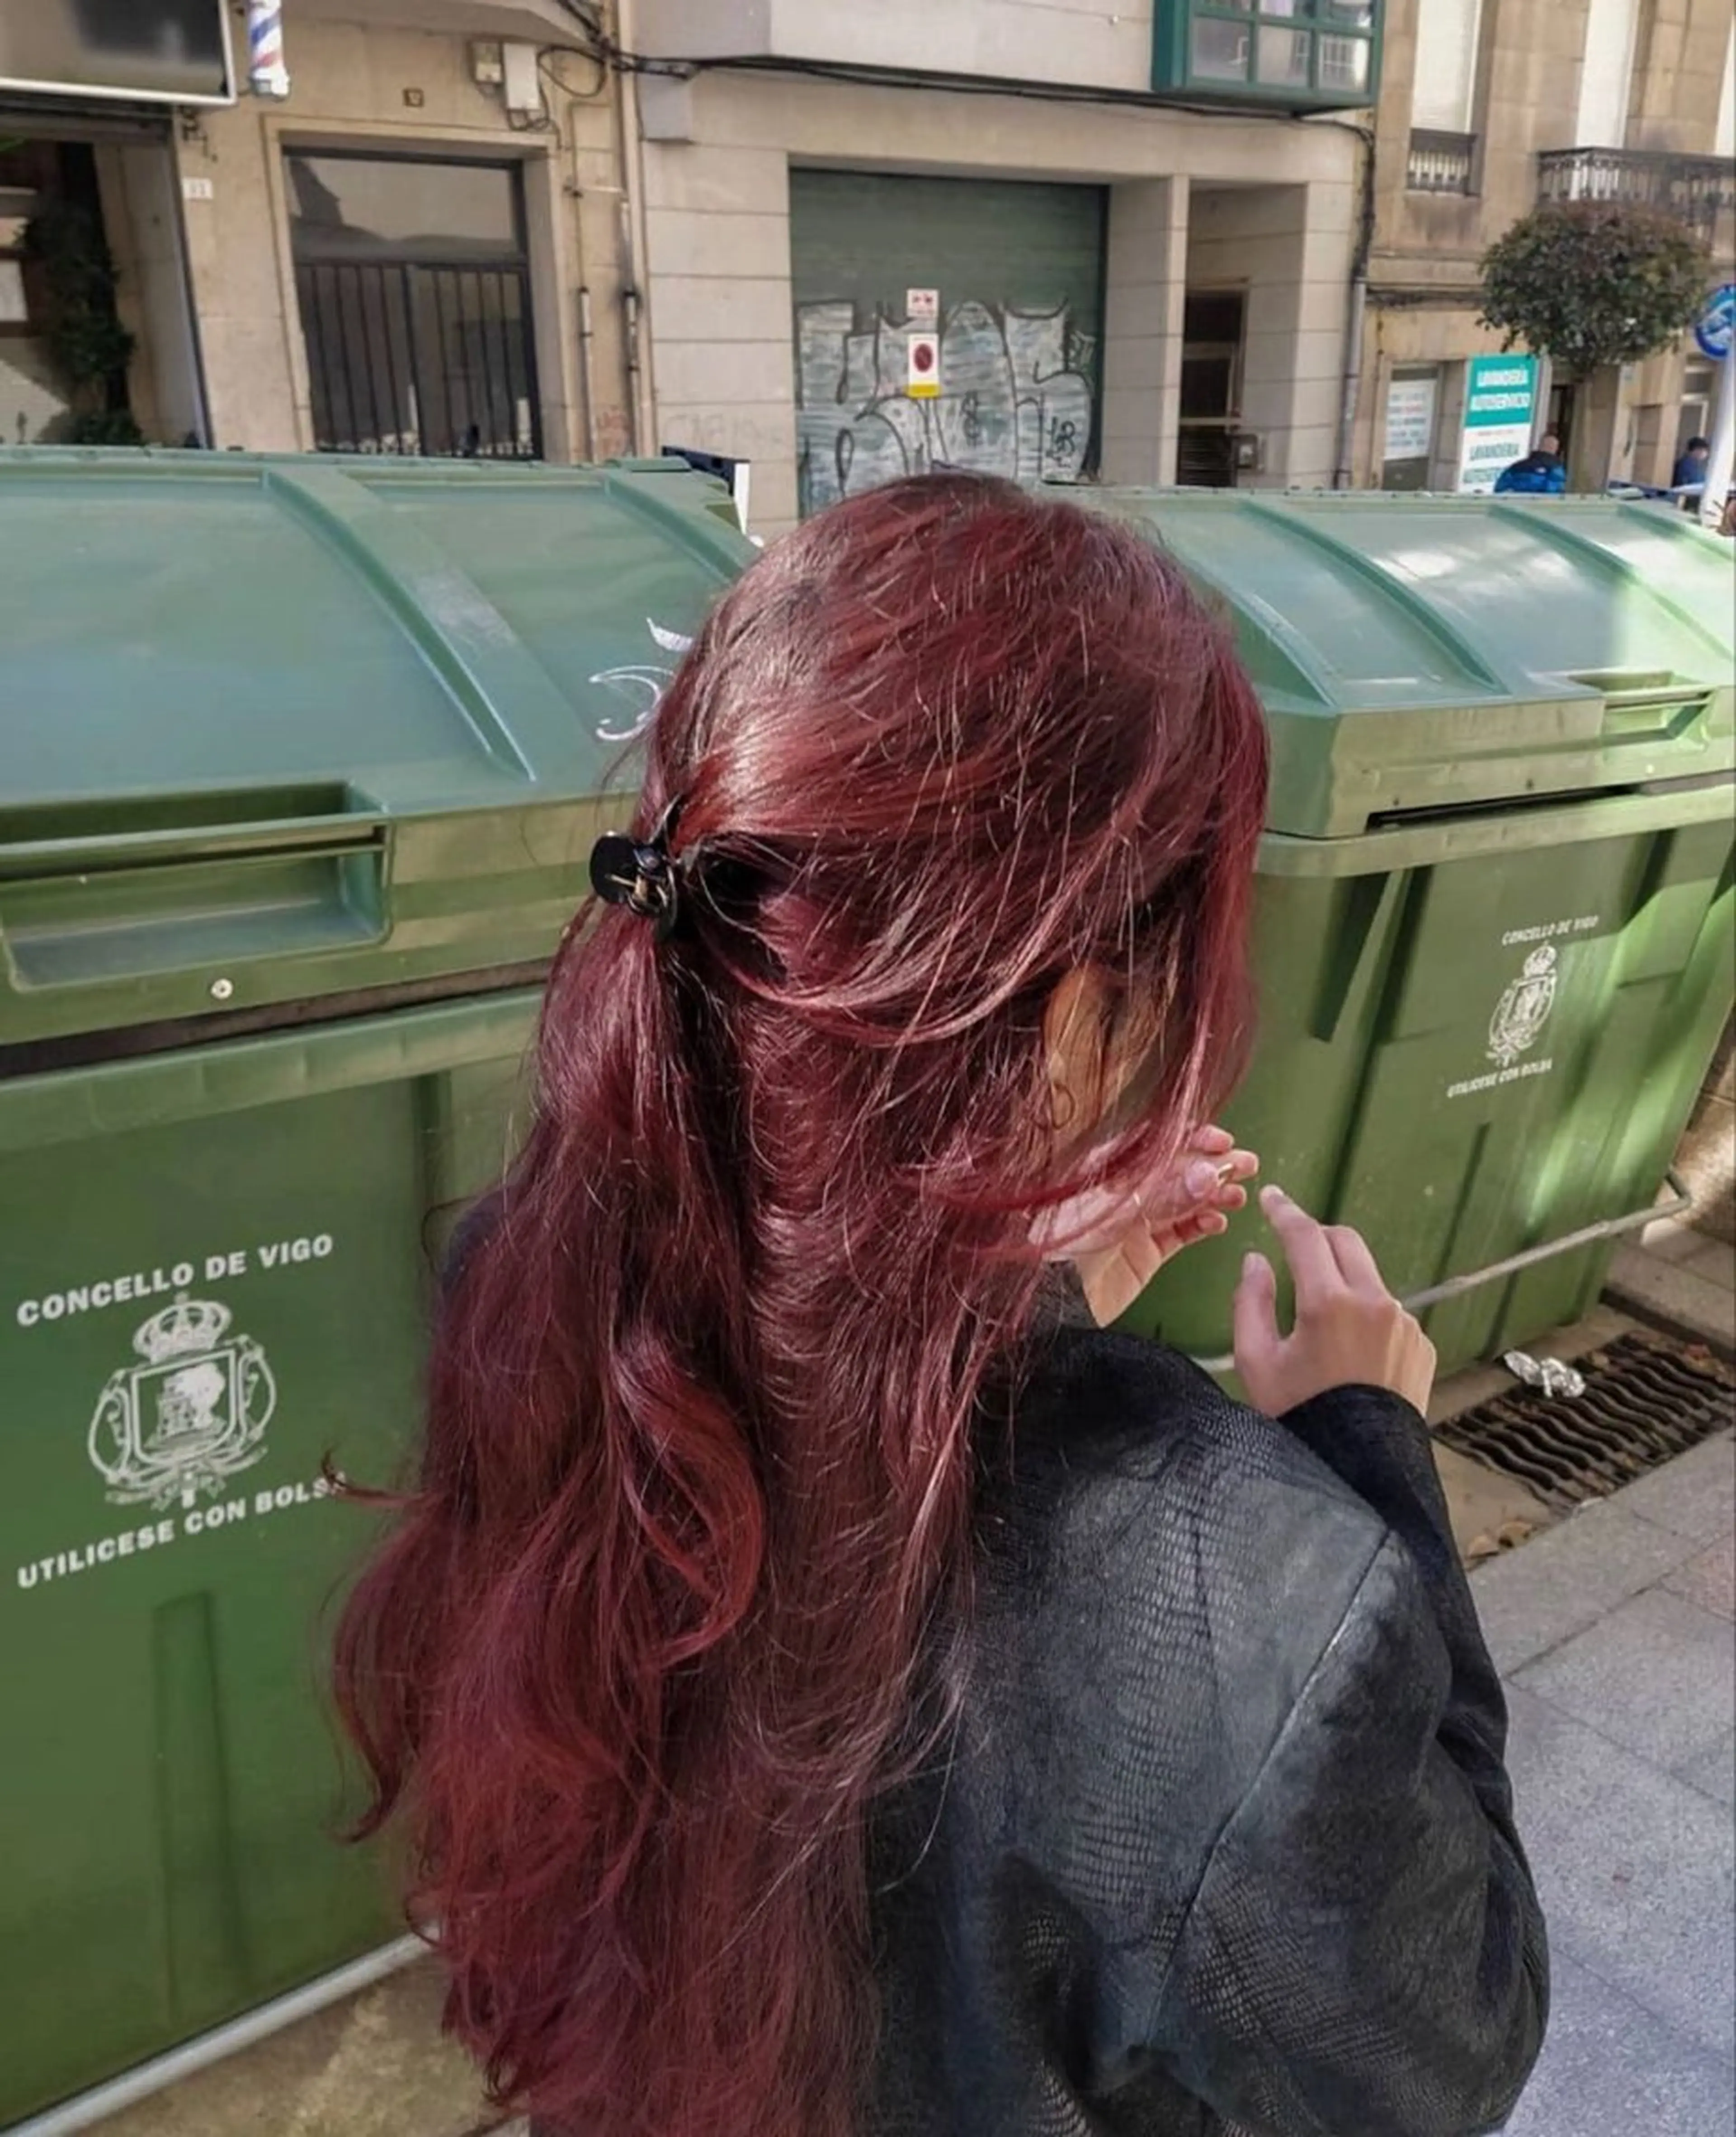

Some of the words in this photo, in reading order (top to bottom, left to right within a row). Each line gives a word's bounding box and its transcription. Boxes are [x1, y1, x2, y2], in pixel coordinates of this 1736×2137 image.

[16, 1262, 194, 1326] CONCELLO
[205, 1251, 246, 1280] DE
[258, 1234, 333, 1268] VIGO
[18, 1519, 175, 1588] UTILICESE
[184, 1498, 246, 1535] CON
